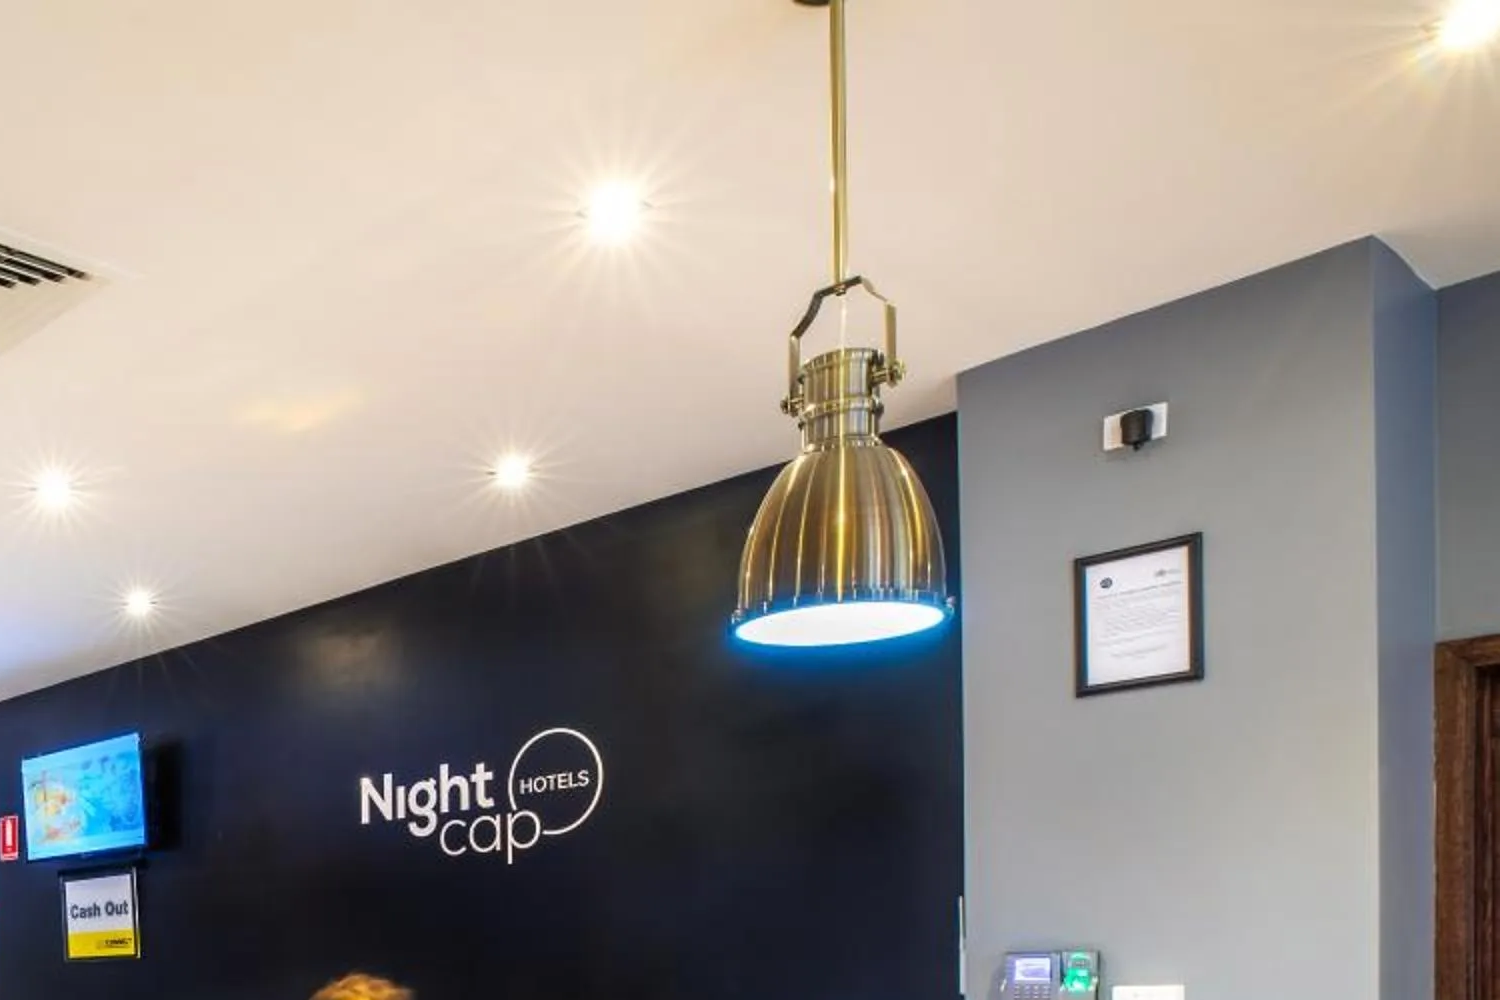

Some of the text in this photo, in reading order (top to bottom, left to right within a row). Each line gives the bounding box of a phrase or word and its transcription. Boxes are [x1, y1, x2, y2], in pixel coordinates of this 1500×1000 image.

[359, 762, 495, 837] Night
[519, 769, 590, 795] HOTELS
[439, 810, 541, 865] cap
[70, 900, 129, 919] Cash Out
